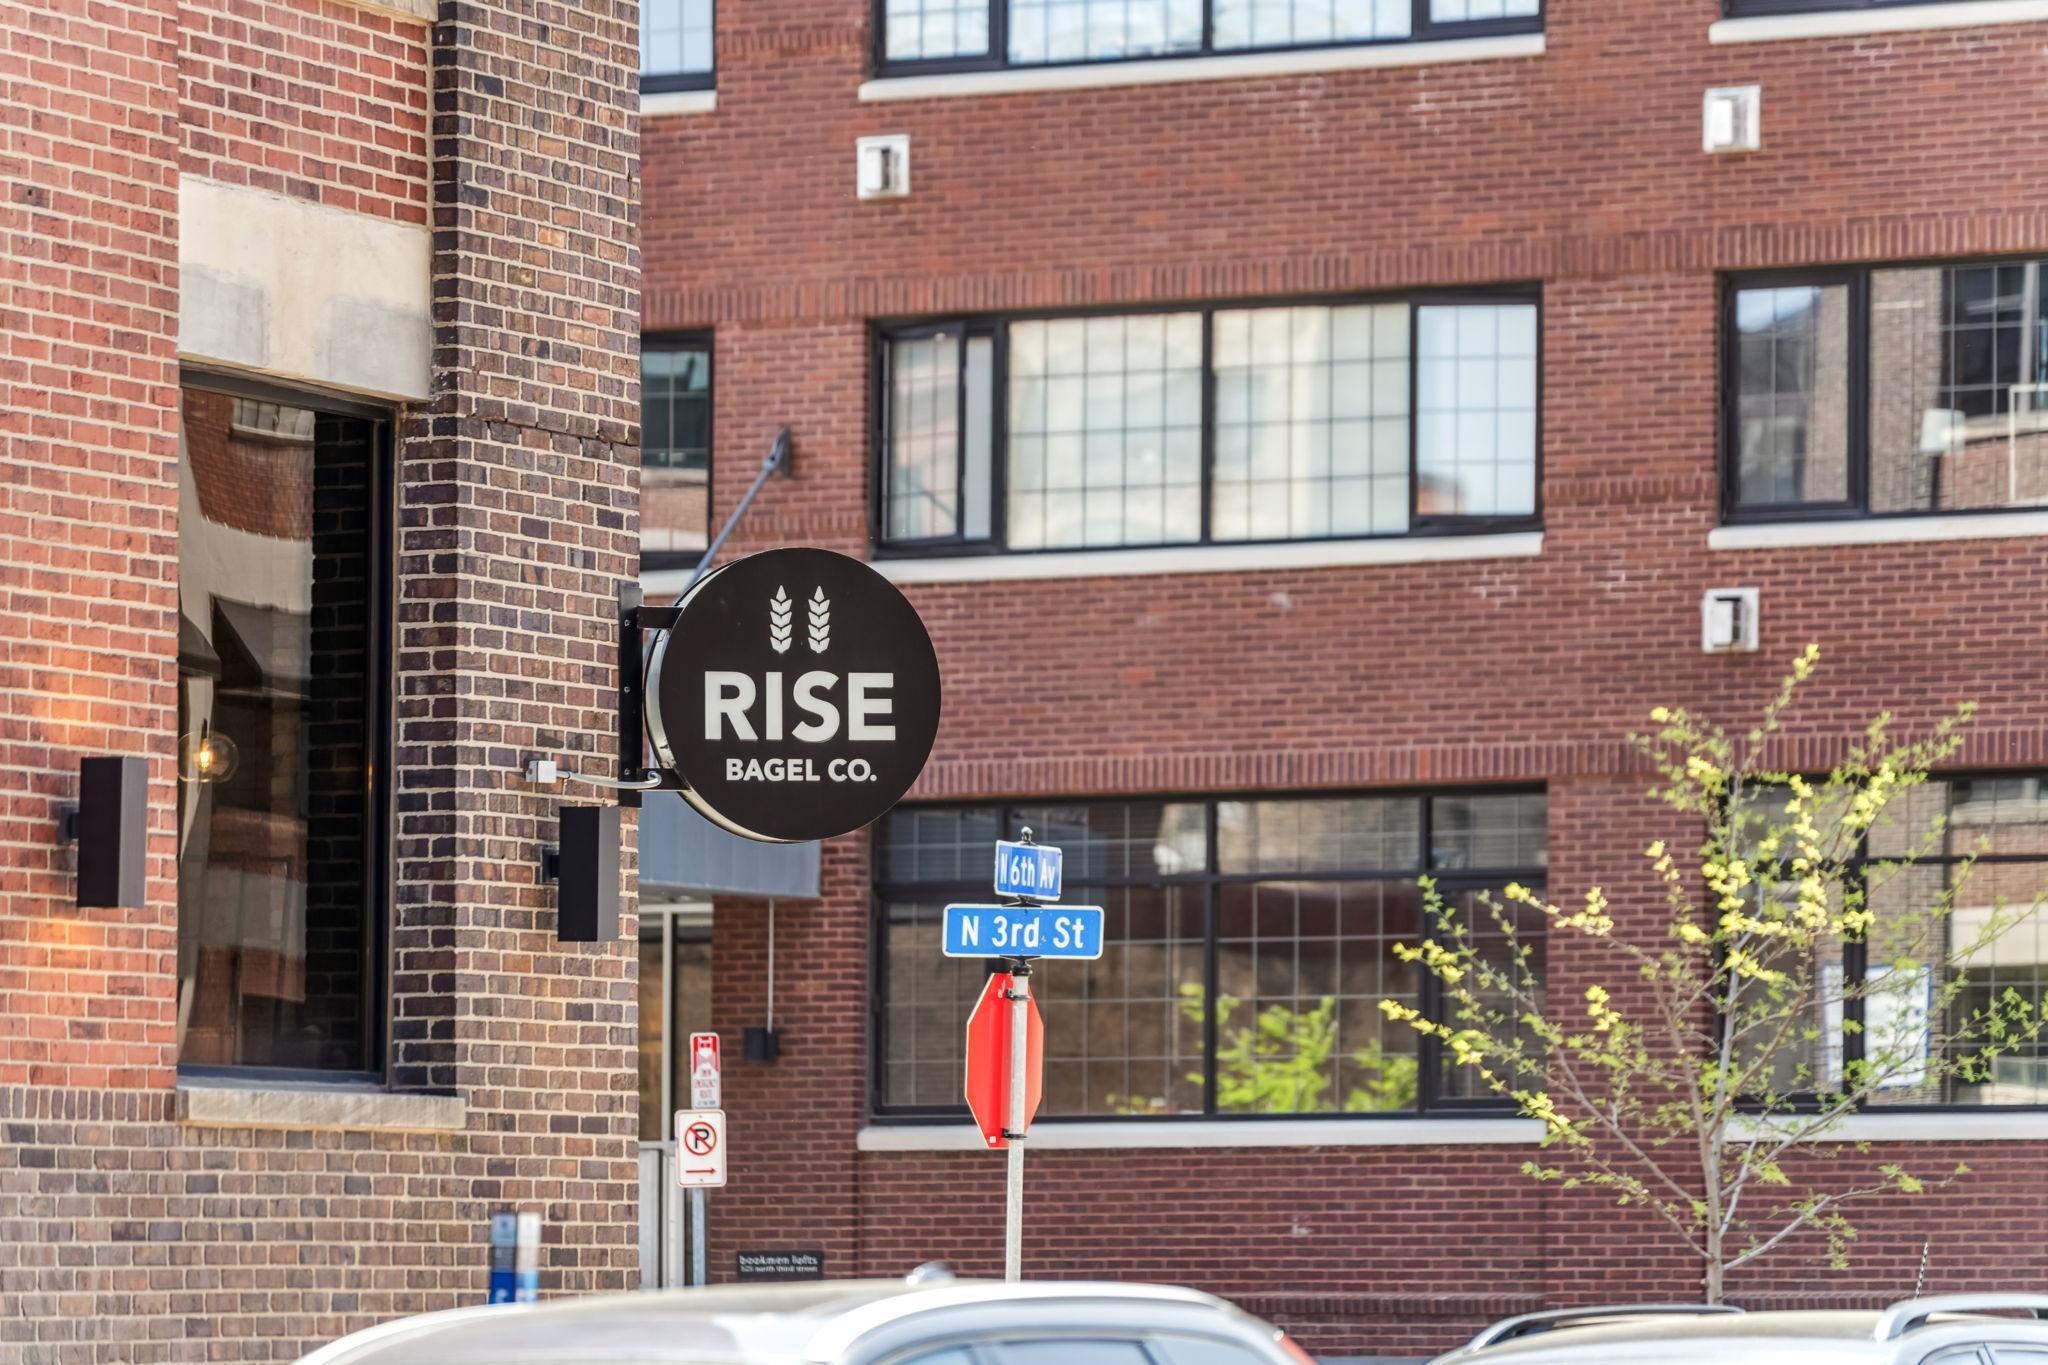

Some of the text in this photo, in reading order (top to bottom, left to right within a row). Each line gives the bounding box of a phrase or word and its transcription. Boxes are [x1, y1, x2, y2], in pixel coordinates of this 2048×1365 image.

[704, 670, 896, 743] RISE
[726, 758, 878, 782] BAGEL CO.
[1000, 853, 1056, 889] N 6th Av
[961, 915, 1085, 949] N 3rd St
